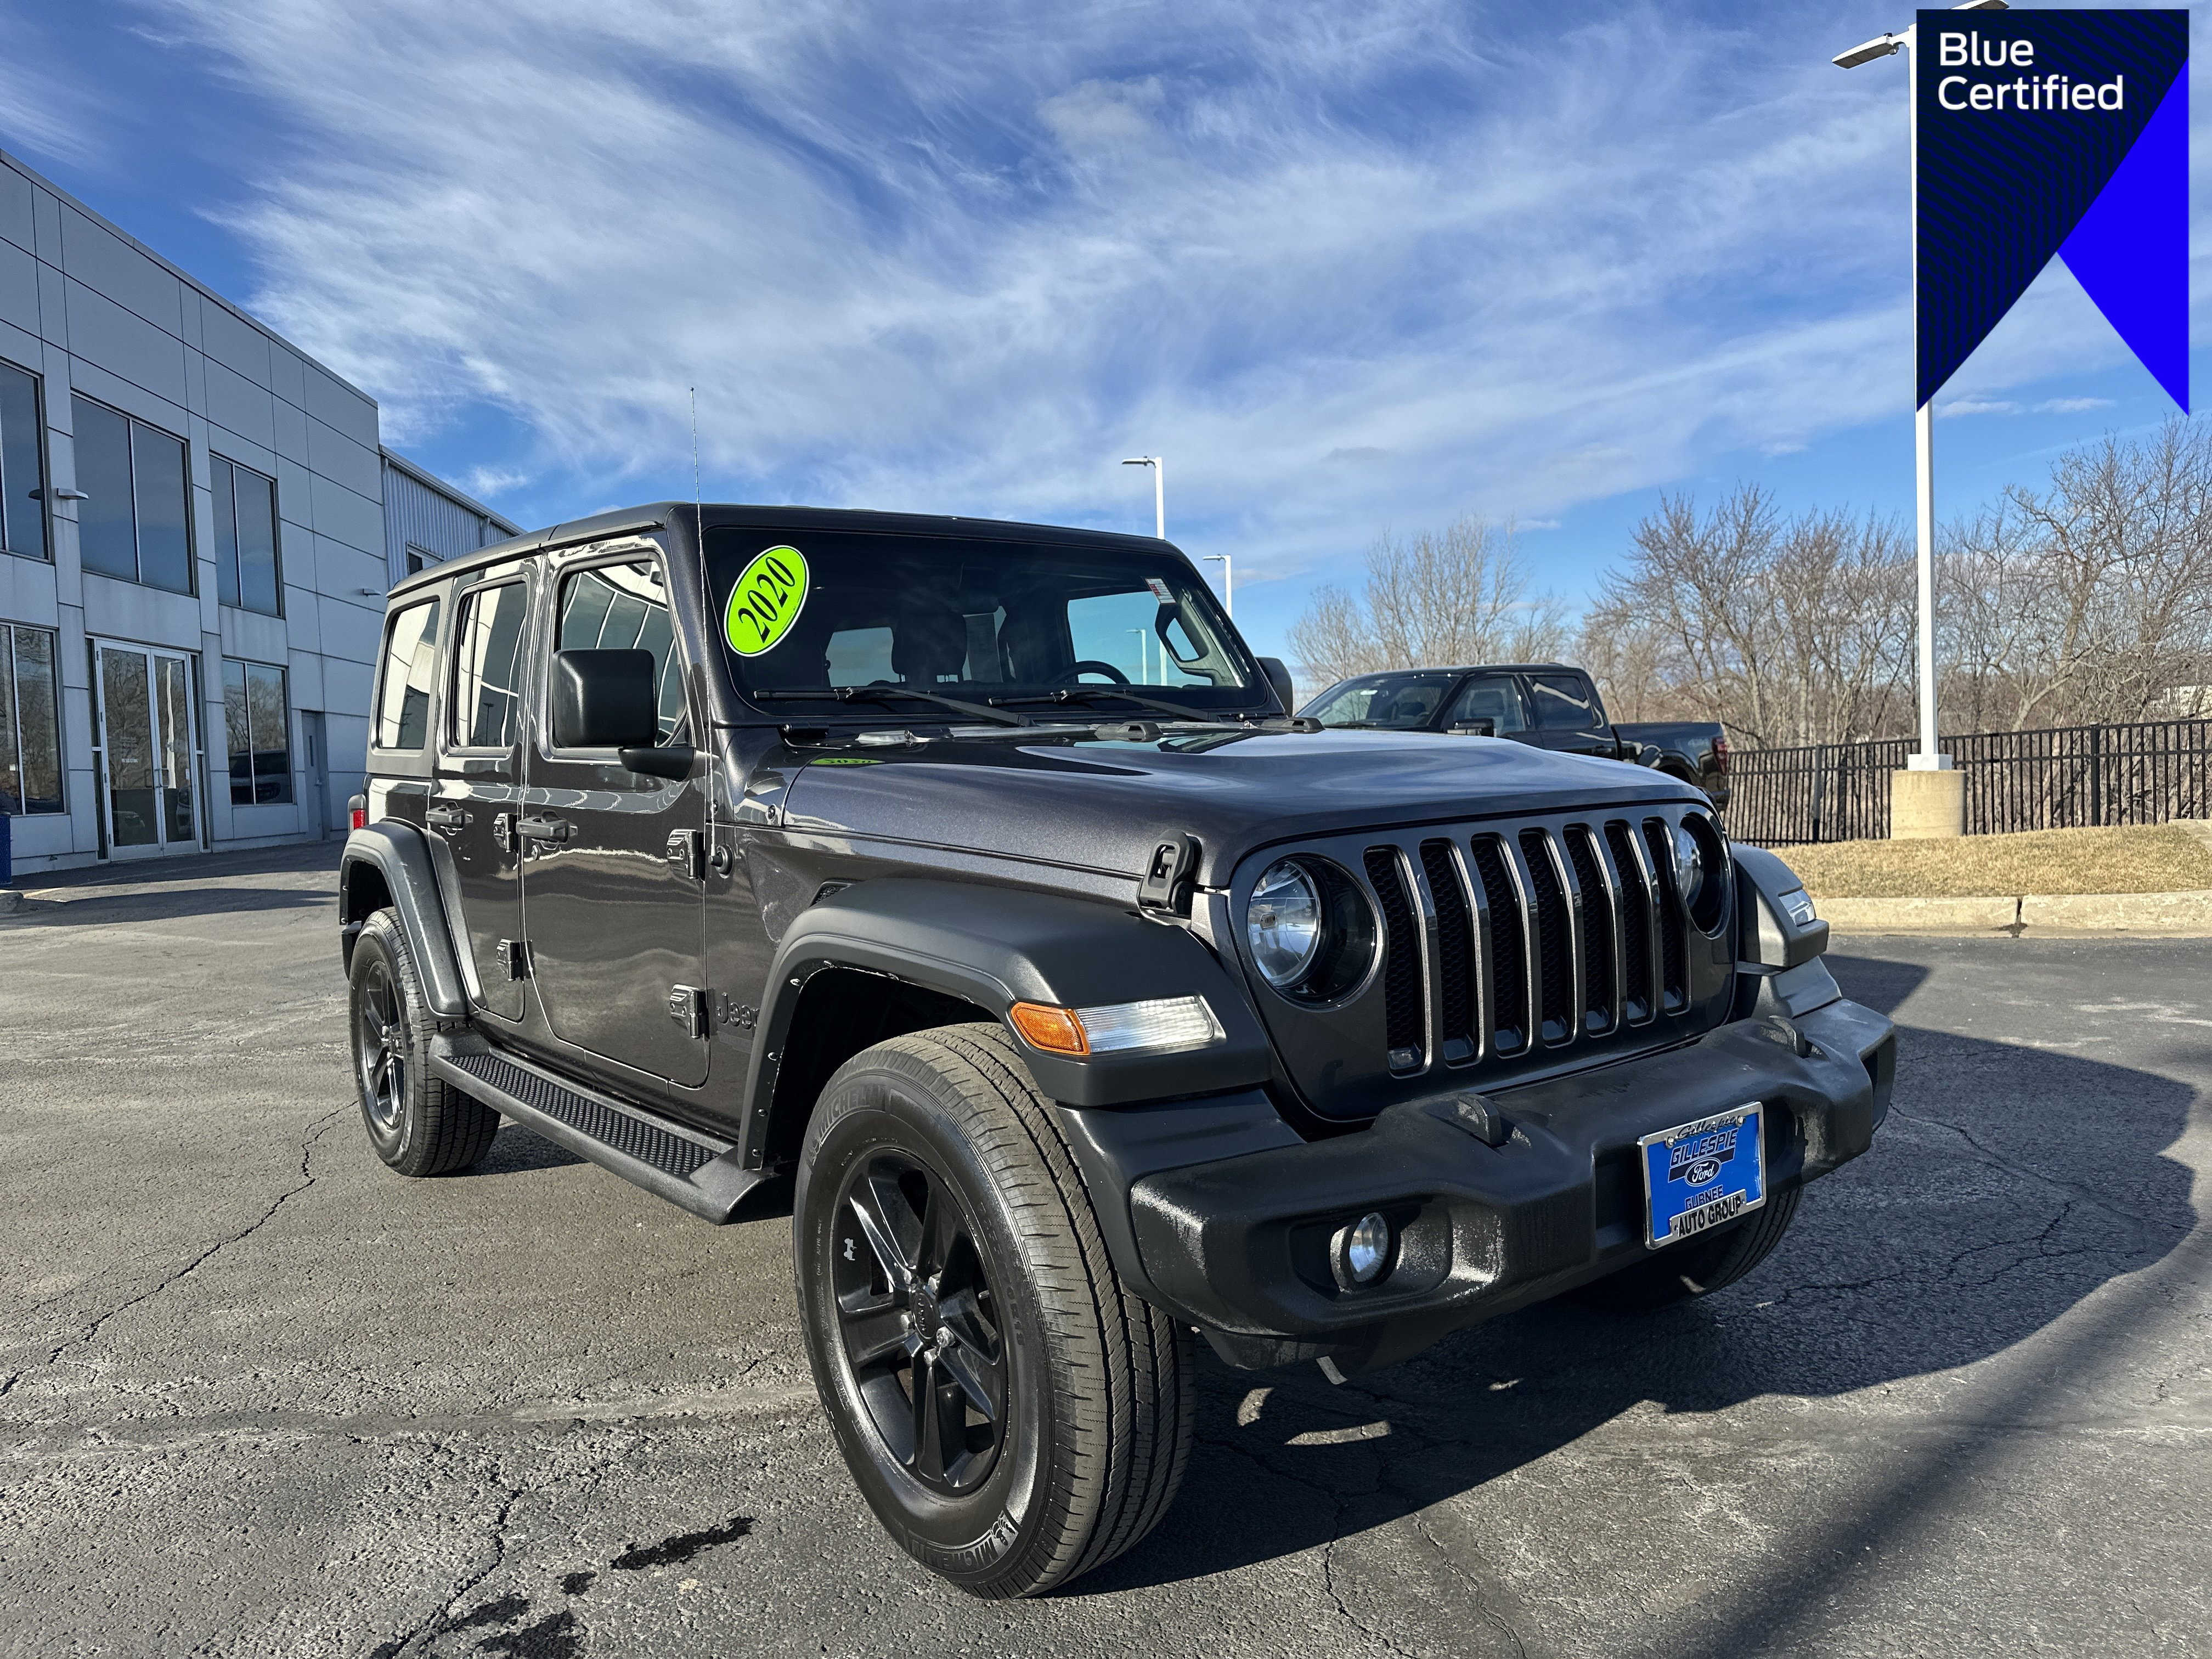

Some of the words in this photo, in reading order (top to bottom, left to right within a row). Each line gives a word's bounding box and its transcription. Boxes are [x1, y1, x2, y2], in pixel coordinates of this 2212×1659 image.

[737, 556, 795, 644] 2020
[1676, 1115, 1736, 1140] Gillespie
[1670, 1127, 1739, 1167] GILLESPIE
[1692, 1162, 1715, 1183] Ford
[1685, 1184, 1724, 1211] GURNEE
[1678, 1209, 1705, 1237] AUTO
[1707, 1194, 1741, 1224] GROUP
